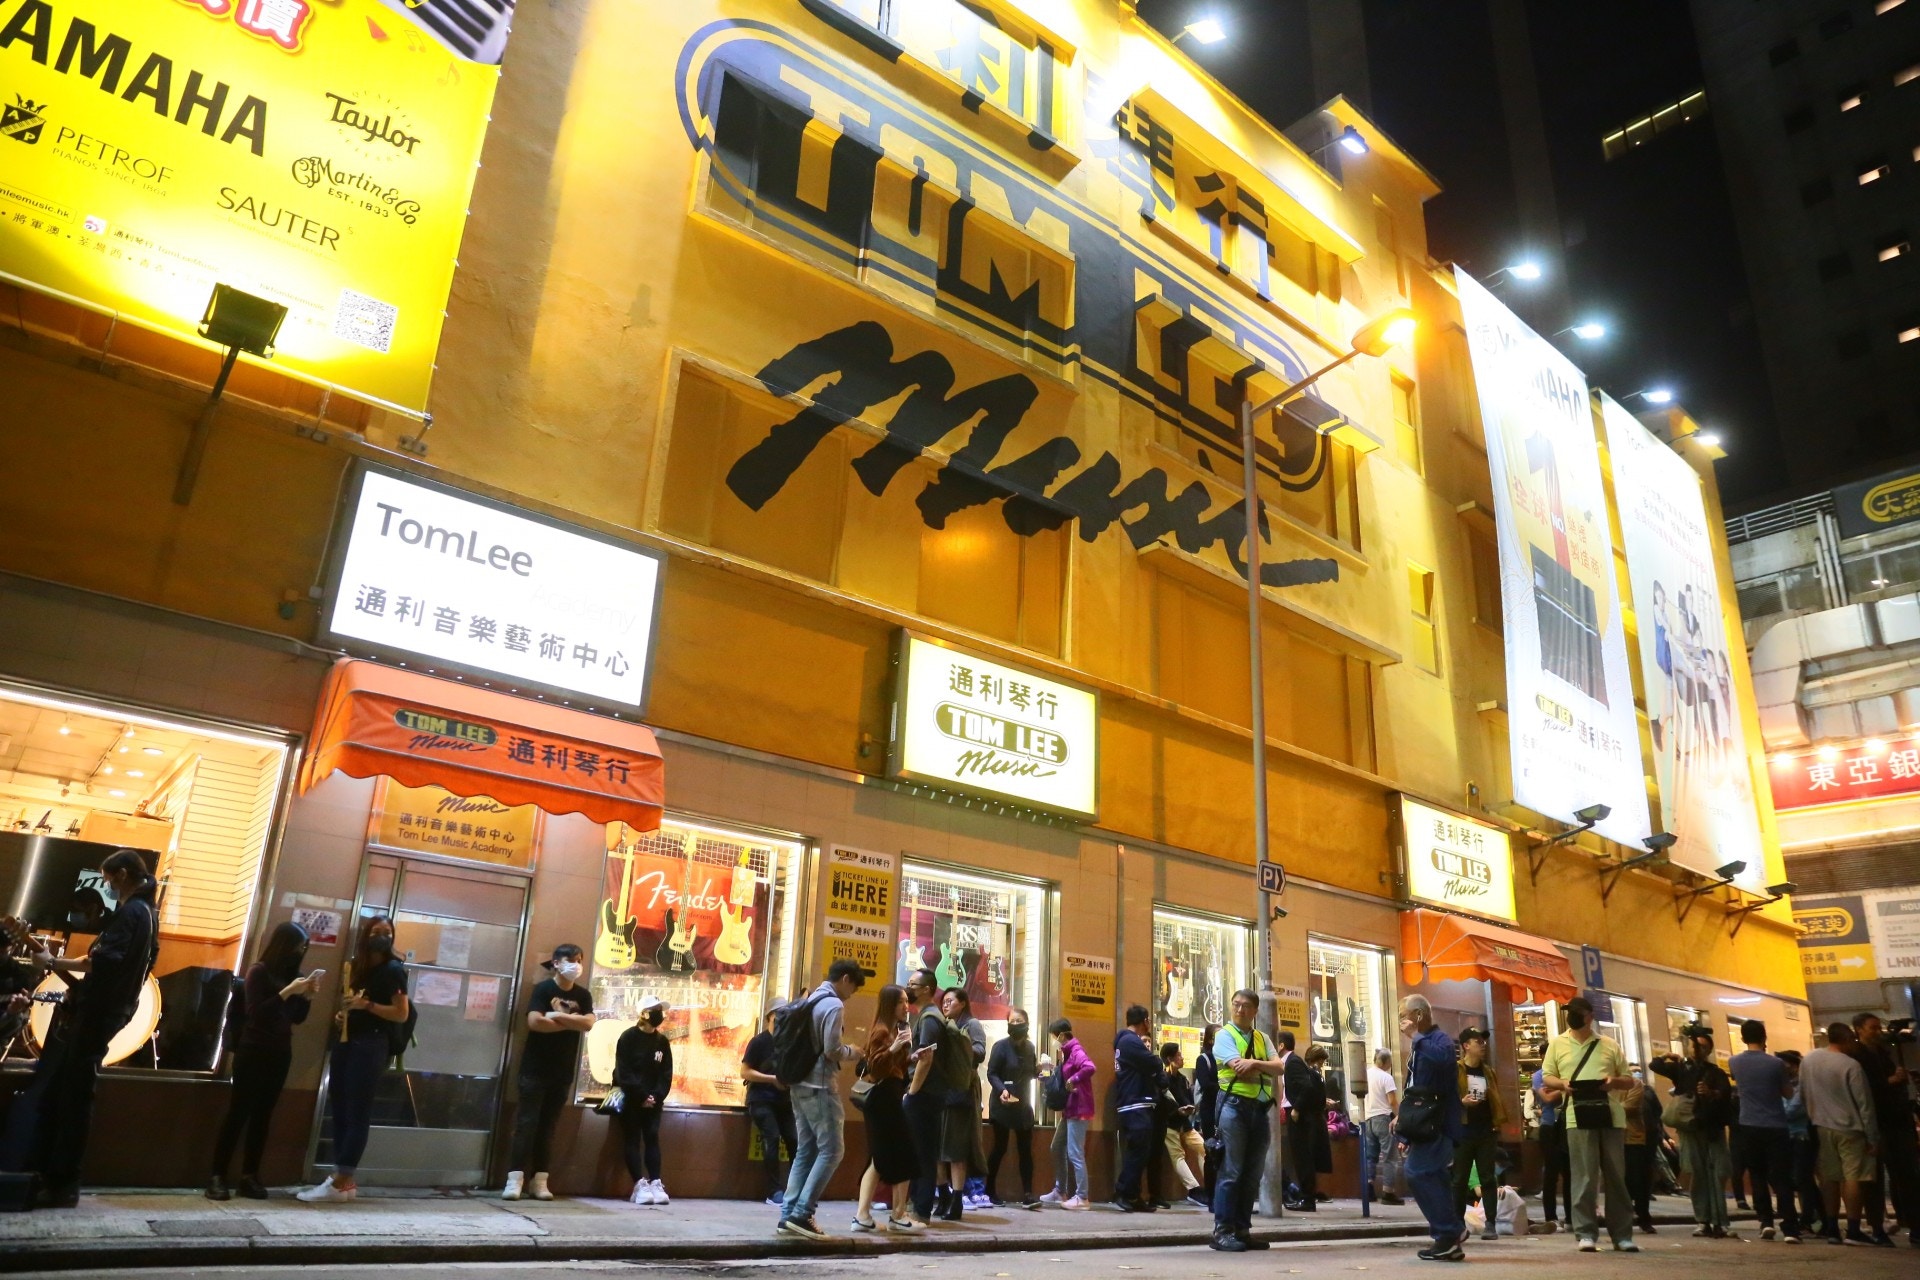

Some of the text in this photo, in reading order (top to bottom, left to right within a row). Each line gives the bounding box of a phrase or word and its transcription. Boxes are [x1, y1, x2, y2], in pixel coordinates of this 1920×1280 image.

[0, 0, 267, 157] AMAHA
[325, 92, 421, 154] Taylor
[52, 147, 98, 170] PIANOS
[57, 126, 174, 183] PETROF
[797, 0, 1278, 303] 利琴行
[215, 186, 340, 251] SAUTER
[328, 187, 389, 218] EST. 1833
[779, 62, 1295, 458] TOM LEE
[725, 320, 1339, 587] Music
[375, 502, 534, 577] TomLee
[354, 583, 631, 679] 通利音樂藝術中心
[949, 663, 1059, 721] 通利琴行
[404, 711, 490, 745] TOM LEE
[408, 733, 488, 752] Music
[947, 707, 1058, 762] TOM LEE
[508, 735, 632, 785] 通利琴行
[954, 750, 1057, 778] Music
[1806, 749, 1920, 791] 東亞銀
[436, 796, 510, 813] Music
[398, 828, 514, 858] Tom Lee Music Academy
[399, 812, 515, 843] 通利音樂藝術中心
[1433, 819, 1484, 854] 通利琴行
[860, 854, 890, 868] 通利琴行
[1263, 867, 1274, 887] P
[635, 870, 724, 912] Fender
[840, 880, 888, 906] HERE
[842, 872, 863, 881] TICKET
[865, 876, 879, 885] LINE
[833, 940, 854, 948] PLEASE
[855, 926, 886, 938] 通利琴行
[832, 946, 878, 960] THIS WAY
[1584, 951, 1599, 983] P
[1071, 978, 1106, 989] THIS WAY
